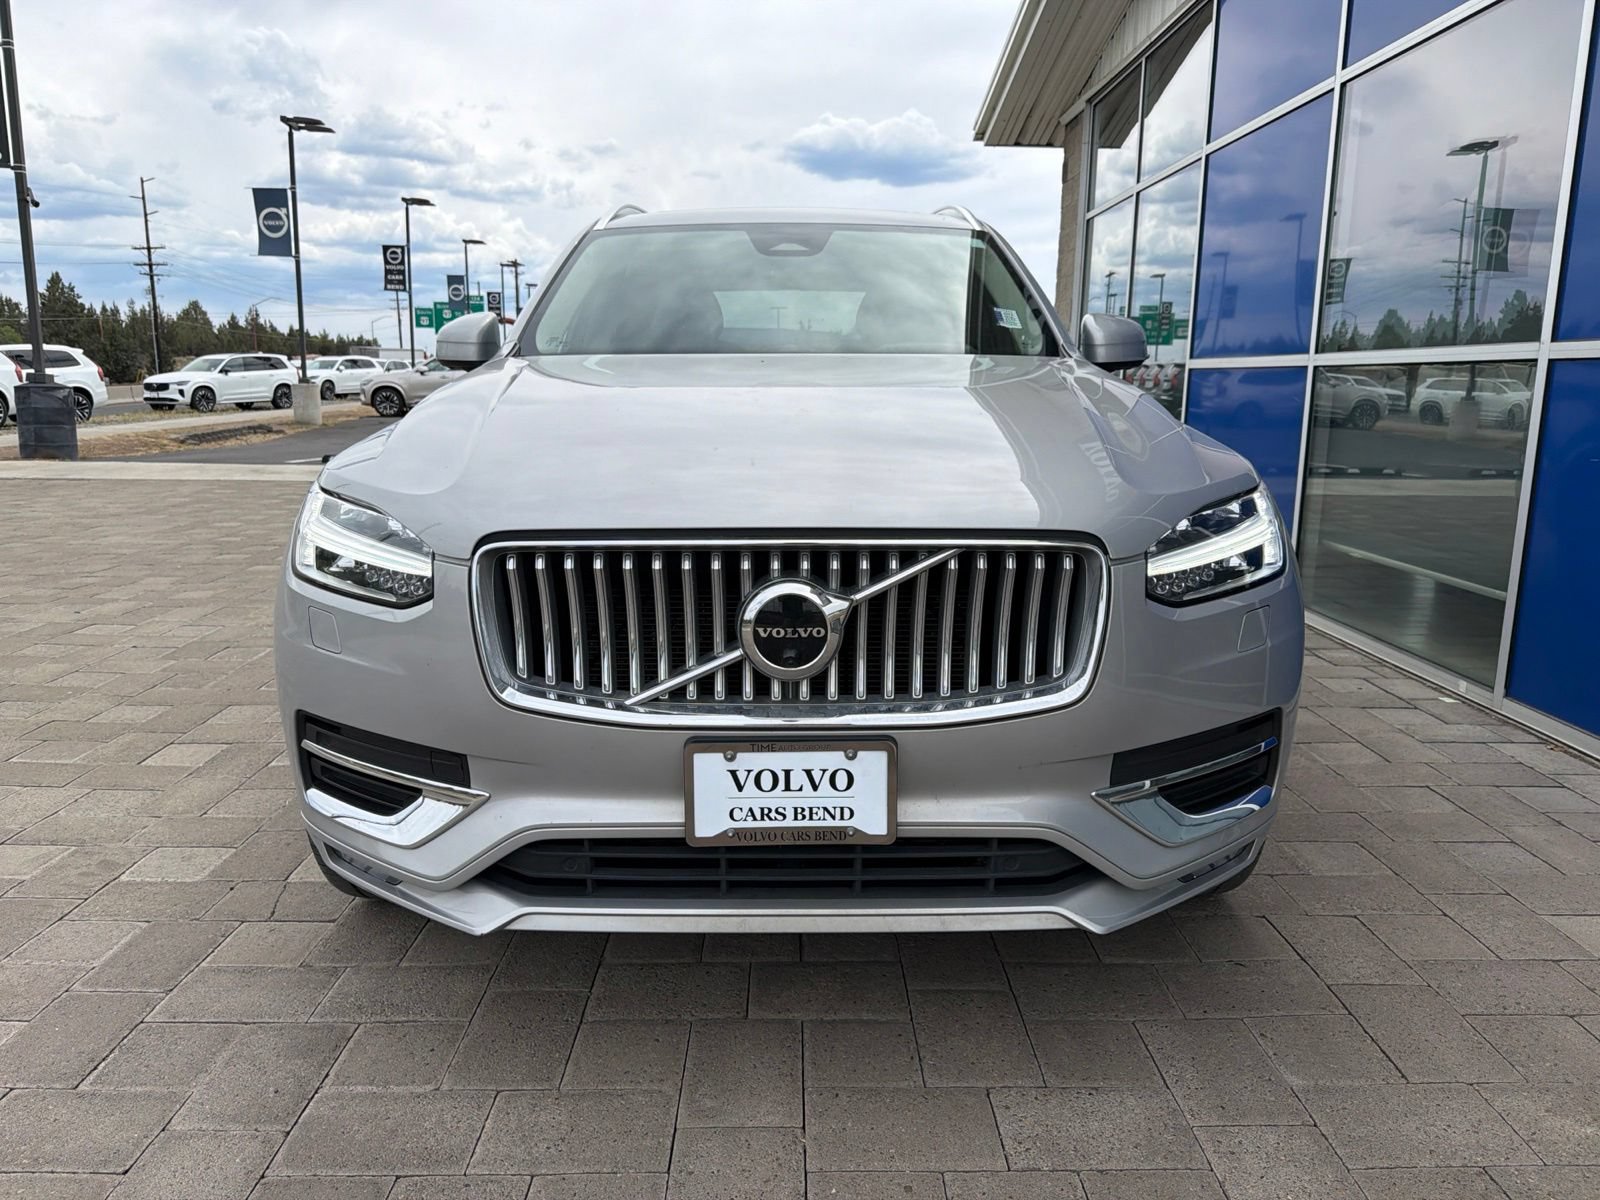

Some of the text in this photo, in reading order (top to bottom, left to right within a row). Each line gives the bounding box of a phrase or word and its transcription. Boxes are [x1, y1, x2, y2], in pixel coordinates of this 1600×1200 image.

[756, 628, 826, 638] VOLVO
[749, 744, 776, 752] TIME
[727, 768, 854, 792] VOLVO
[729, 806, 854, 822] CARS BEND
[736, 830, 846, 842] VOLVO CARS BEND
